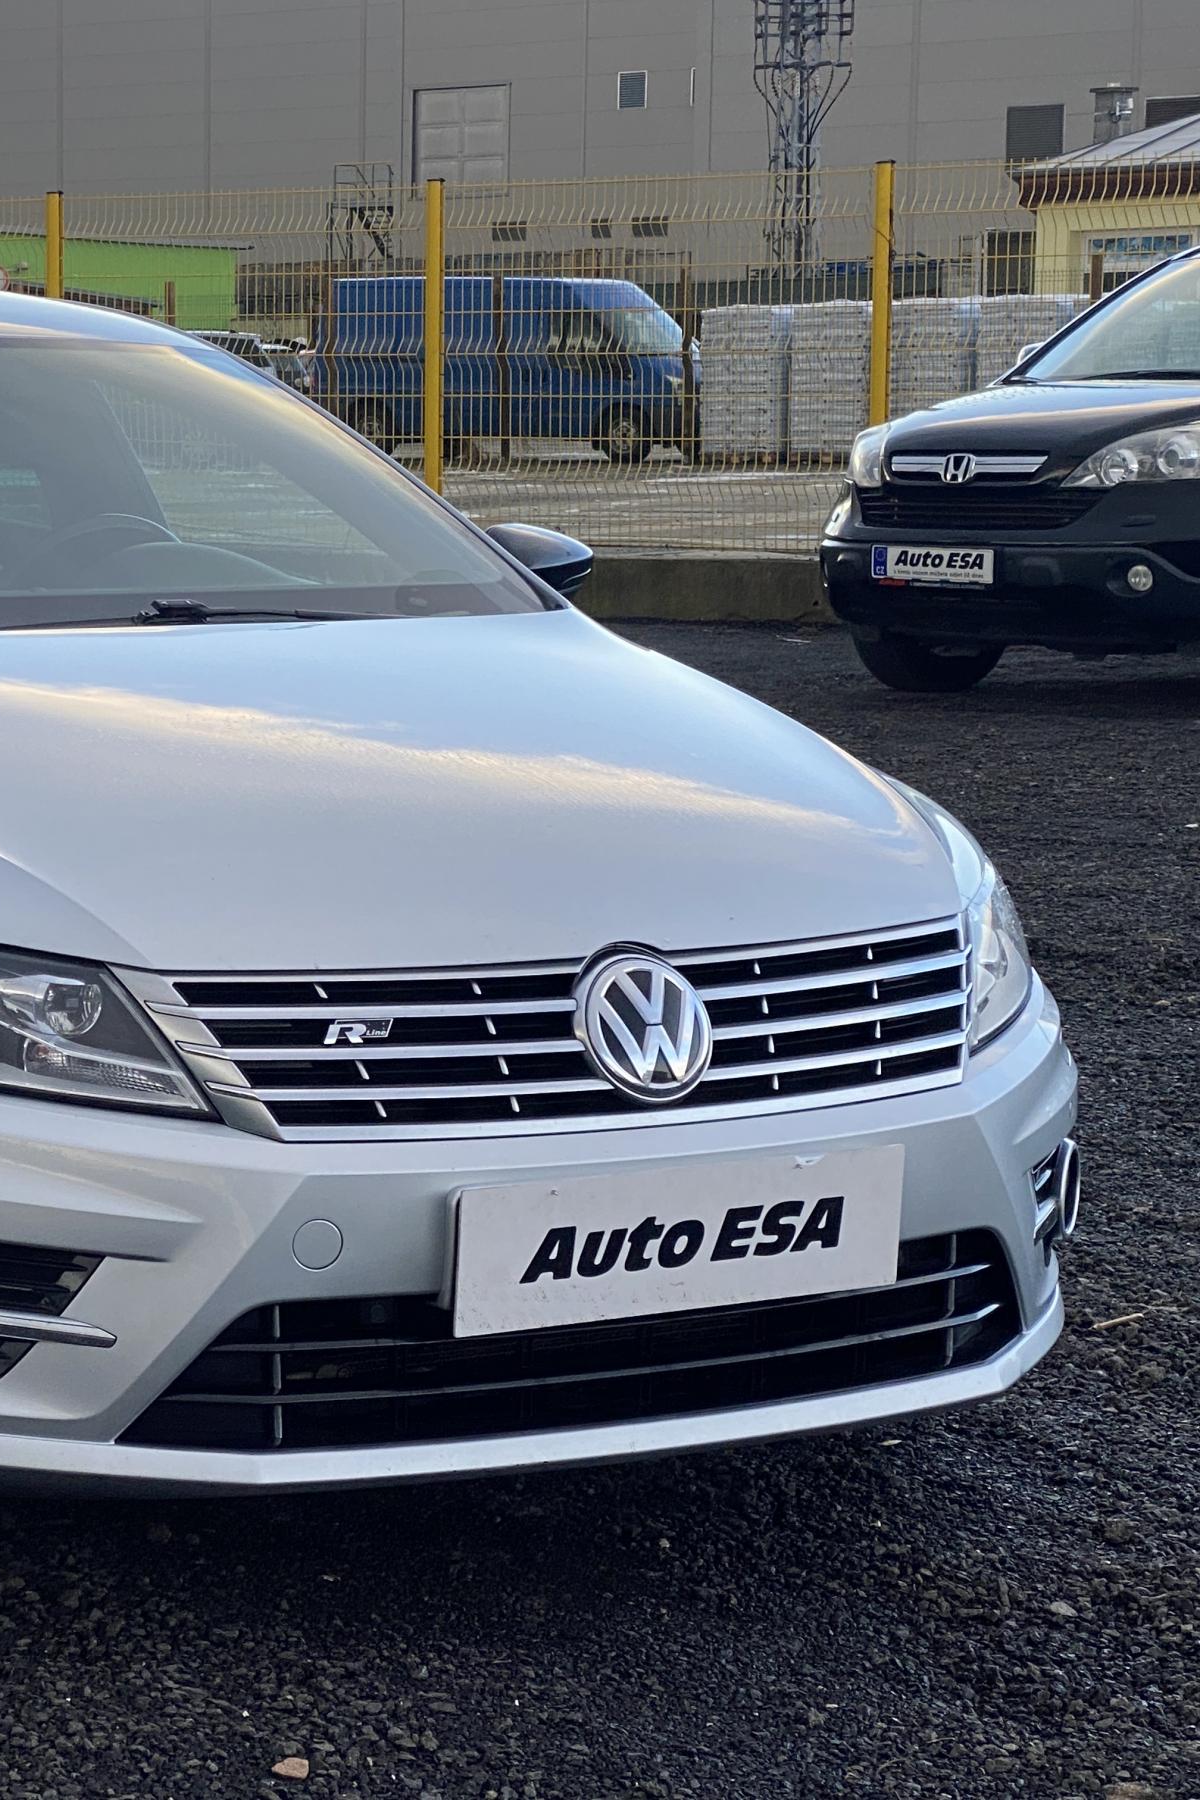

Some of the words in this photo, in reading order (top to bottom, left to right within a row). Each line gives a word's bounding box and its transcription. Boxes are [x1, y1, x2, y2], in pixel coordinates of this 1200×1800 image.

[875, 566, 885, 575] CZ
[895, 550, 944, 568] Auto
[946, 552, 984, 570] ESA
[323, 1023, 367, 1045] R
[519, 1216, 705, 1284] Auto
[710, 1196, 845, 1262] ESA
